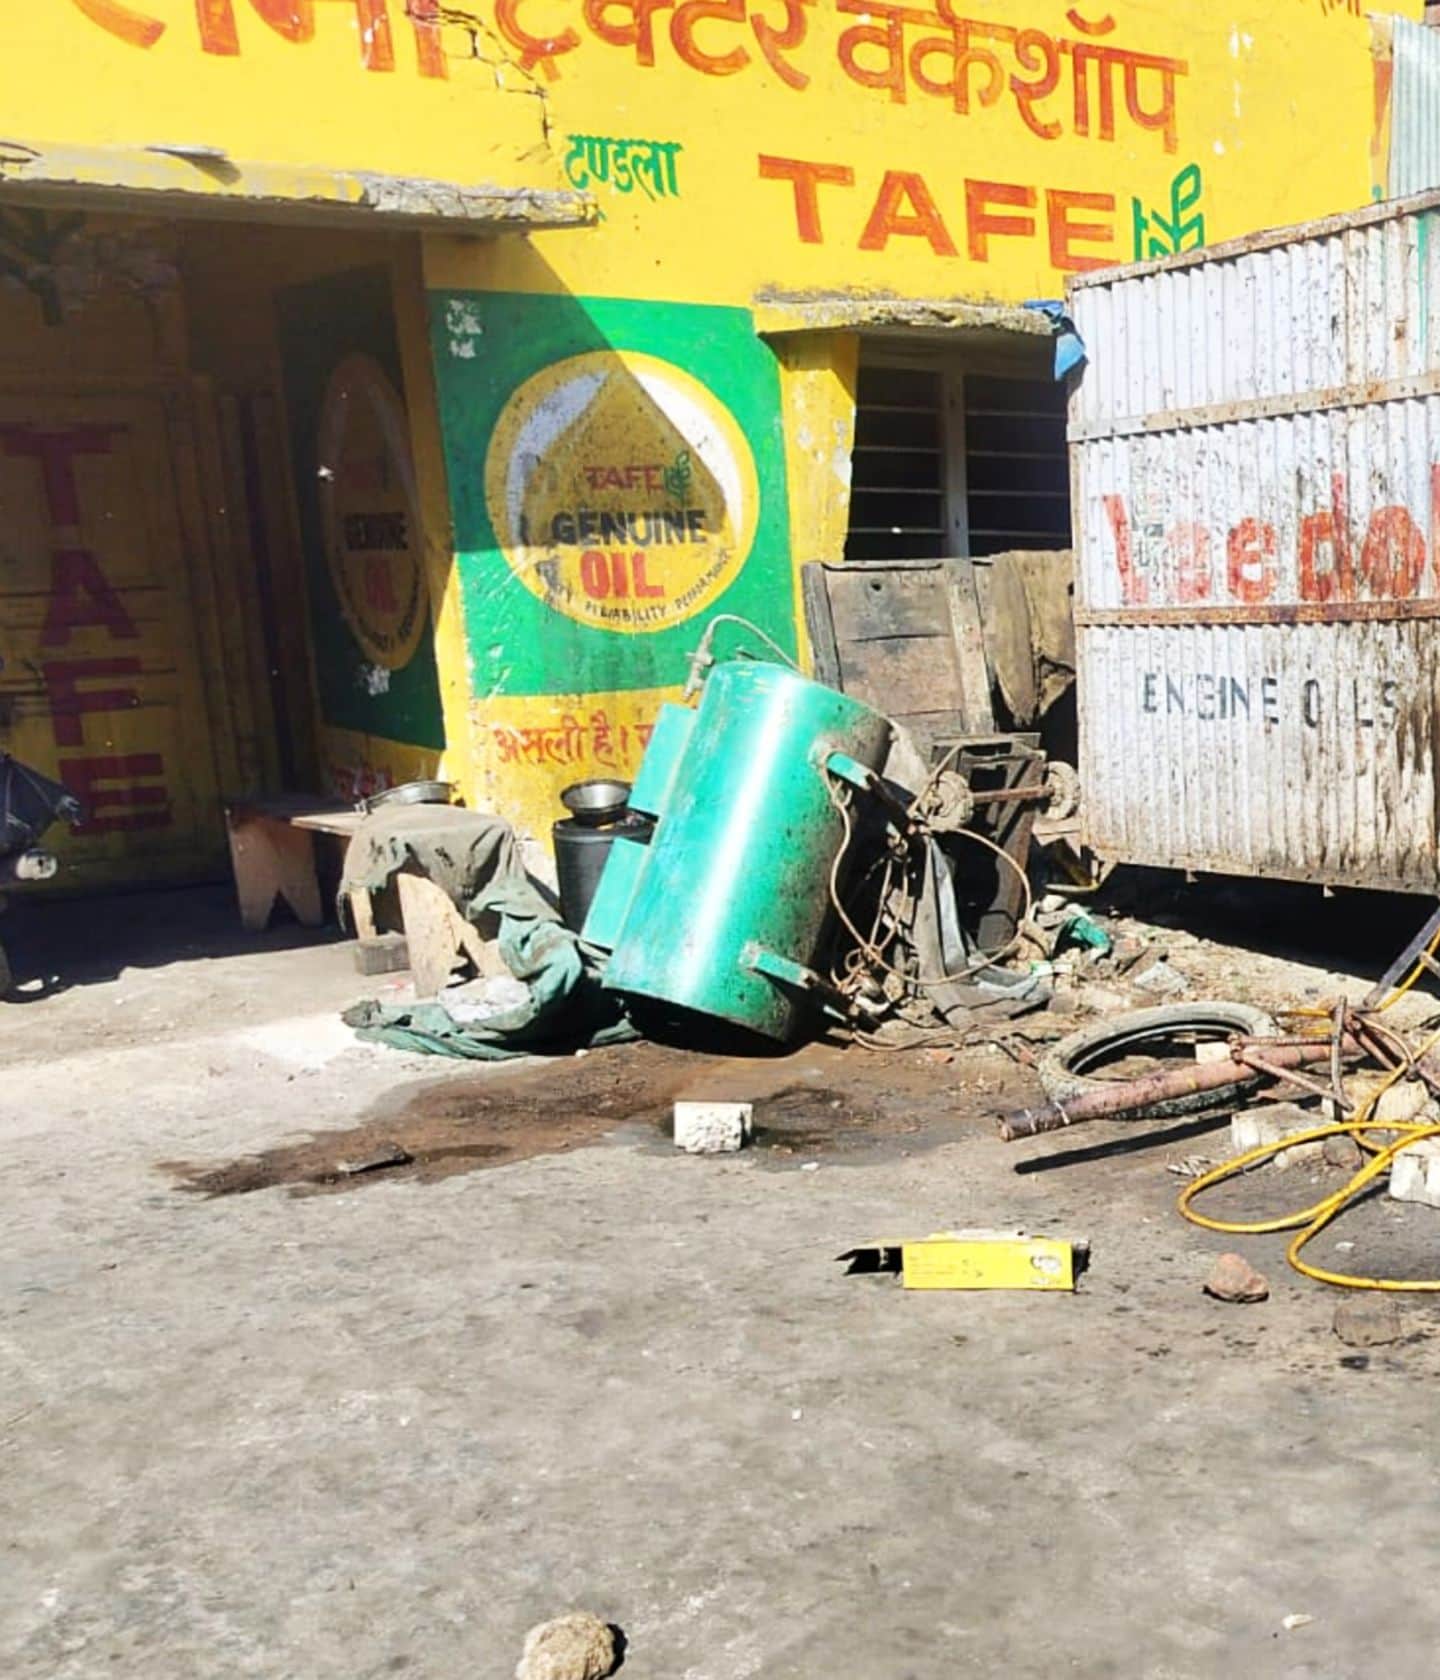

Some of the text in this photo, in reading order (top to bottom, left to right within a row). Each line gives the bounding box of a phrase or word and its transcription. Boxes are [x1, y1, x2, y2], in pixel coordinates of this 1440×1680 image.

[758, 153, 1122, 273] TAFE
[582, 463, 665, 491] TAFE
[551, 507, 709, 547] GENUINE
[579, 549, 665, 600] OIL
[0, 430, 173, 837] TAFE
[1141, 672, 1397, 729] ENGINE OLS
[493, 713, 588, 767] असली
